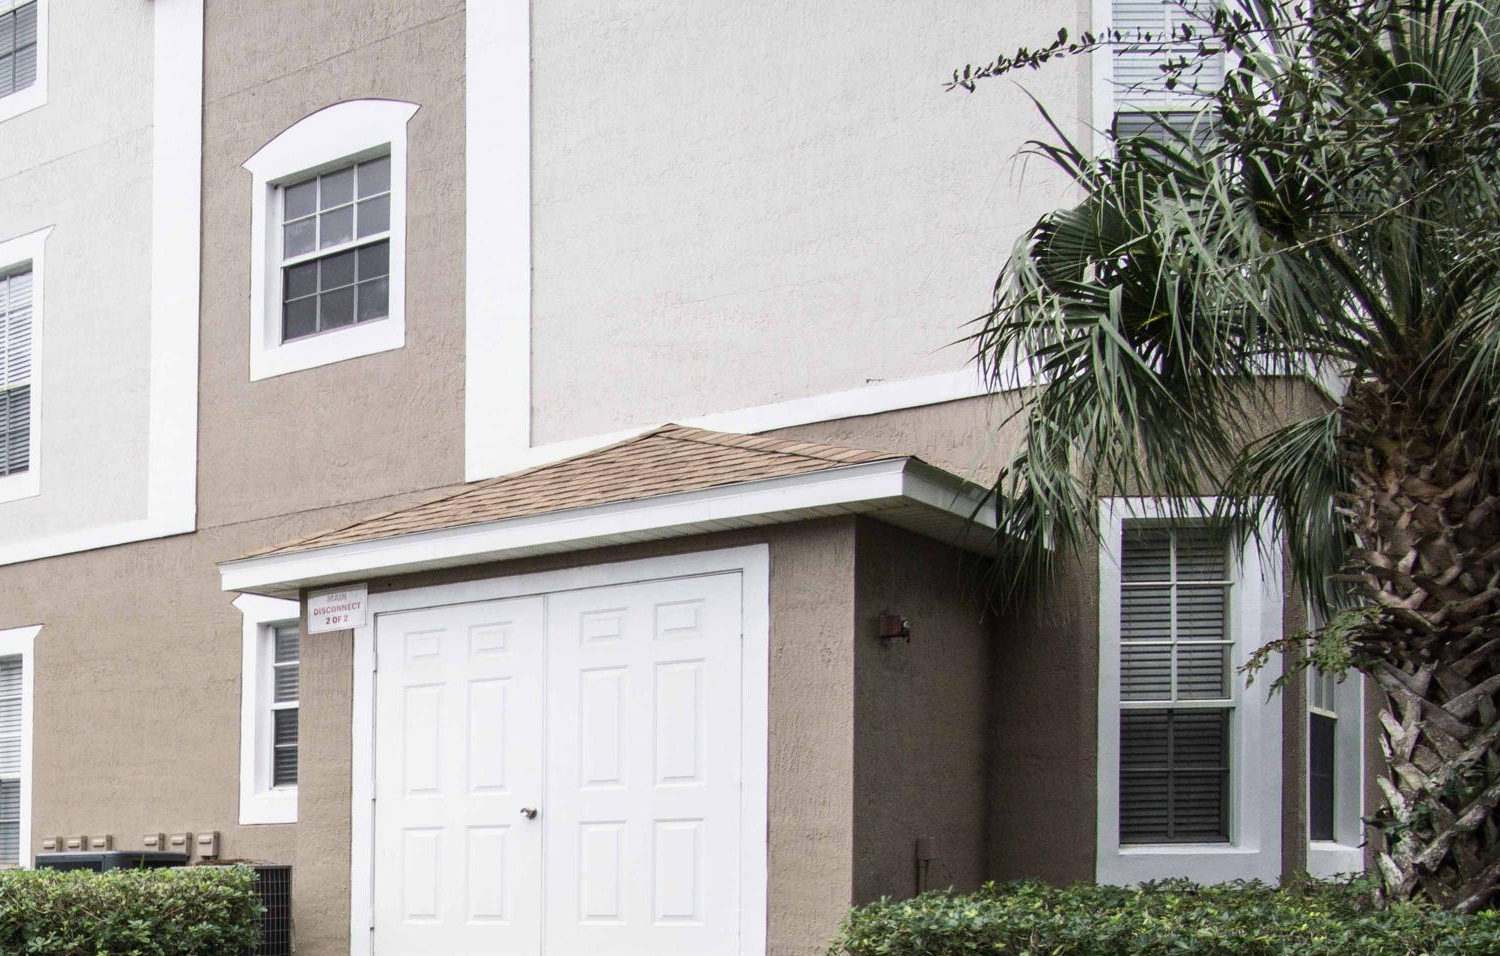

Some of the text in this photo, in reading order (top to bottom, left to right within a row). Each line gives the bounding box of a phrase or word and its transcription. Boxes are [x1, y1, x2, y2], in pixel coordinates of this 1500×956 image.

[313, 602, 361, 616] DISCONNECT
[325, 617, 331, 625] 2
[332, 616, 342, 624] OF
